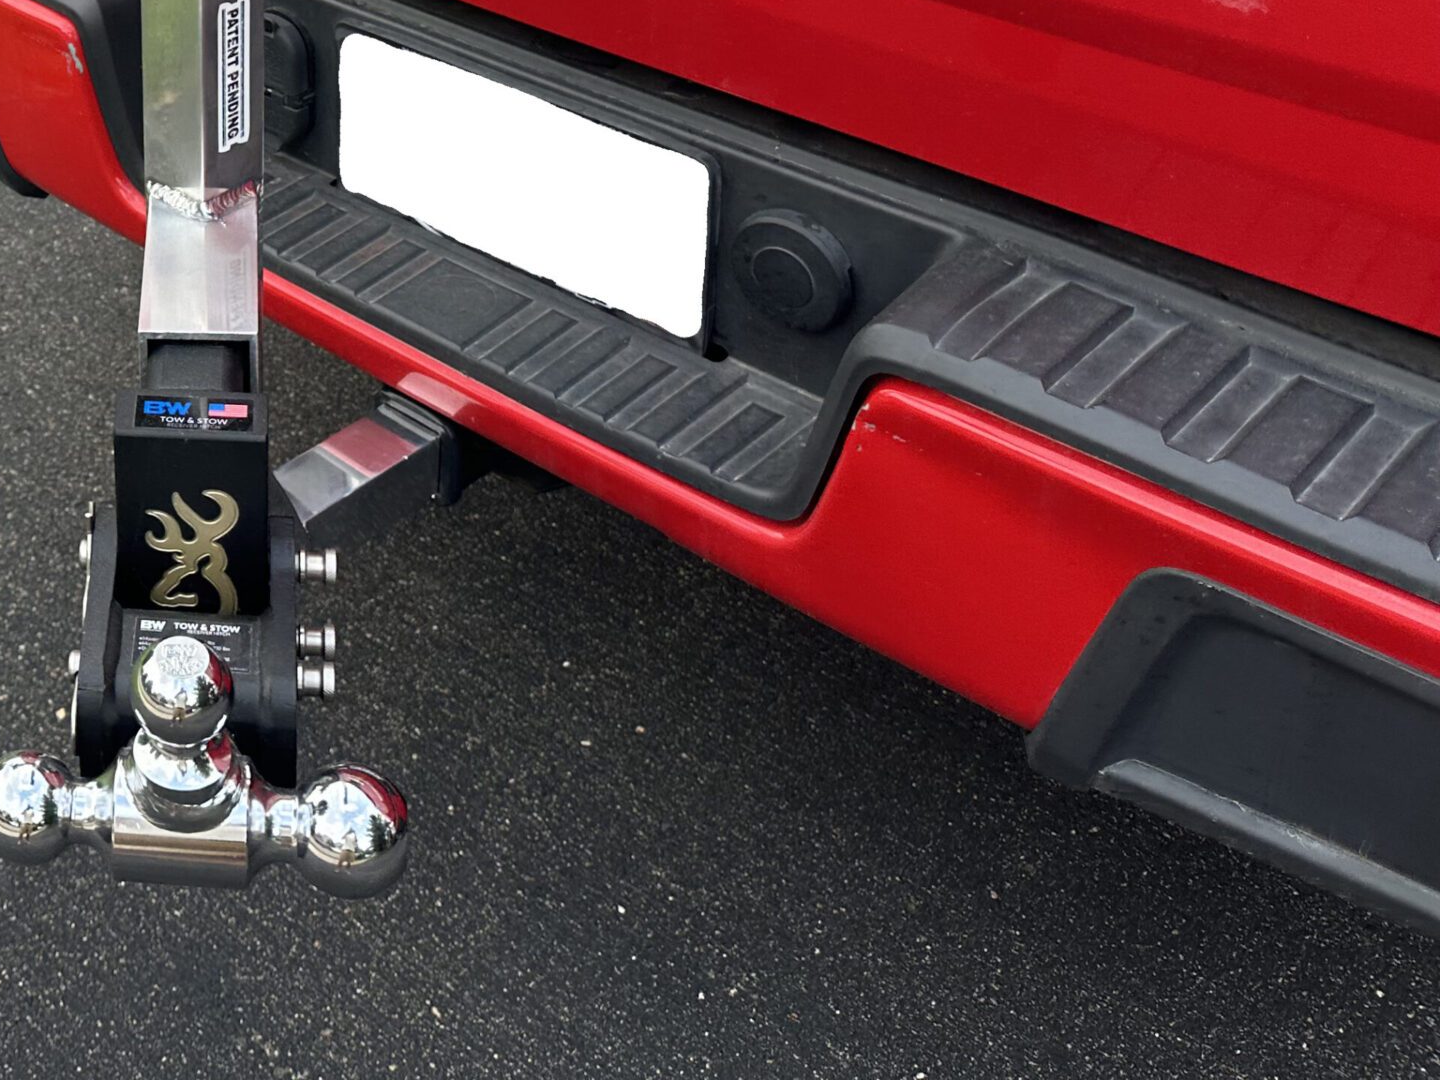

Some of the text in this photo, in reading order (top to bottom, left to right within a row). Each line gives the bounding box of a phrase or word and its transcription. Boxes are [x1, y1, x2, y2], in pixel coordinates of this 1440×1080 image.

[226, 7, 239, 140] PATENT PENDING
[160, 416, 185, 424] TOW
[197, 417, 228, 425] STOW
[173, 622, 198, 631] TOW
[200, 623, 207, 631] &
[210, 624, 240, 634] STOW
